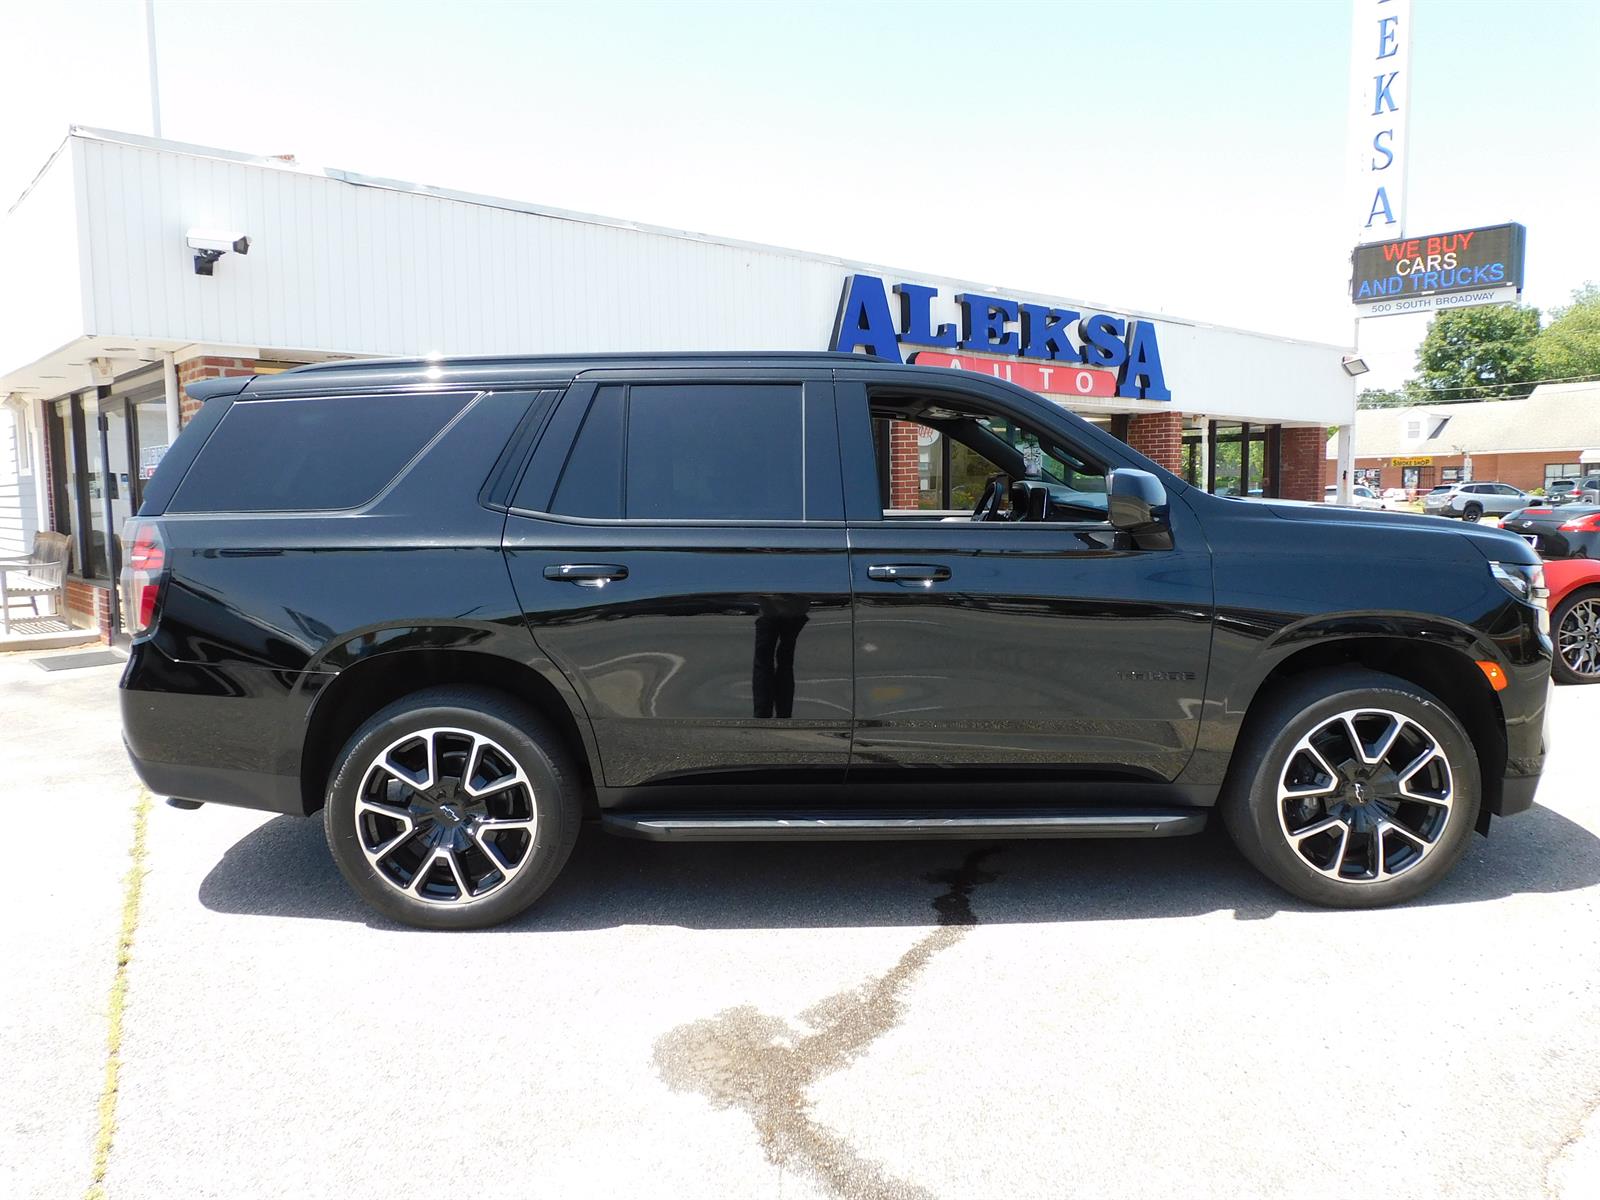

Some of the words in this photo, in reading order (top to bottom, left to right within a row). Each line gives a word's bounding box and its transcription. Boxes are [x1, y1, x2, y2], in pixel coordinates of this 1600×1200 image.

[1364, 0, 1399, 228] EKSA
[1383, 240, 1420, 261] WE
[1427, 232, 1475, 255] BUY
[1396, 252, 1457, 276] CARS
[1358, 276, 1403, 298] AND
[1410, 263, 1505, 291] TRUCKS
[1371, 304, 1392, 313] 500
[1396, 299, 1431, 310] SOUTH
[1435, 291, 1495, 306] BROADWAY
[829, 274, 1171, 401] ALEKSA
